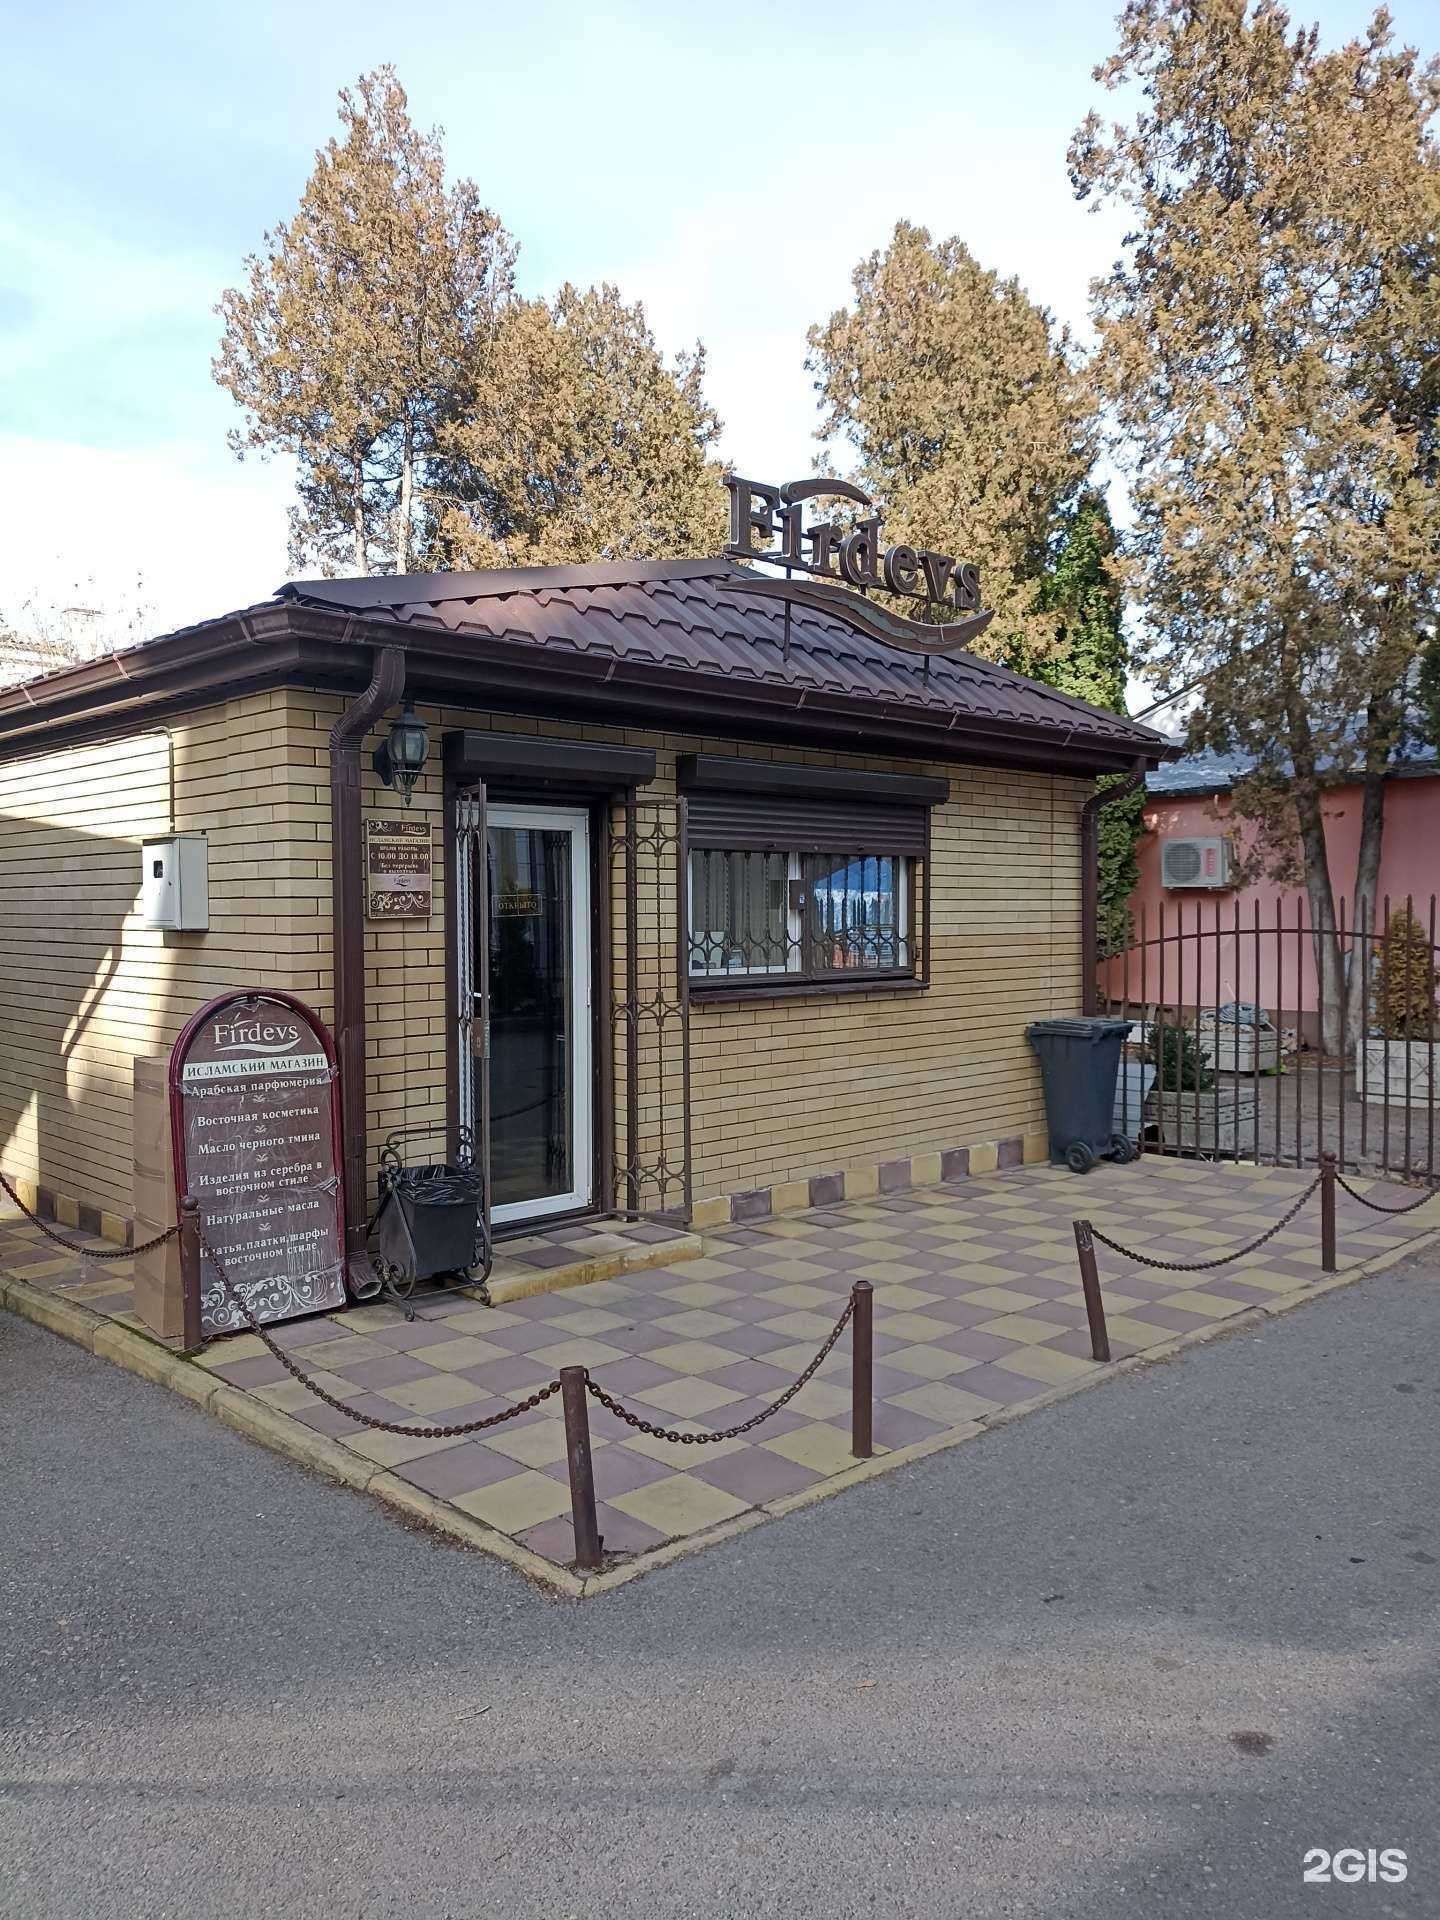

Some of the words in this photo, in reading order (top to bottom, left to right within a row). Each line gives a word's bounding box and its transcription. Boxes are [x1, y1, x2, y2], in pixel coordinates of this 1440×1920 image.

[723, 475, 982, 611] Firdevs
[213, 1020, 299, 1045] Firdevs
[270, 1057, 324, 1070] МАГАЗИН
[191, 1084, 247, 1098] Арабская
[251, 1077, 322, 1091] парфюмерия
[197, 1113, 258, 1127] Восточная
[262, 1106, 319, 1120] косметика
[198, 1143, 236, 1155] Масло
[239, 1137, 284, 1150] черного
[288, 1133, 320, 1144] тмина
[199, 1172, 249, 1186] Изделия
[254, 1170, 267, 1178] из
[270, 1162, 313, 1177] серебра
[316, 1161, 322, 1169] в
[216, 1181, 275, 1196] восточном
[278, 1175, 309, 1187] стиле
[206, 1207, 284, 1226] Натуральные
[287, 1200, 320, 1213] масла
[224, 1248, 284, 1266] восточном
[287, 1241, 317, 1255] стиле
